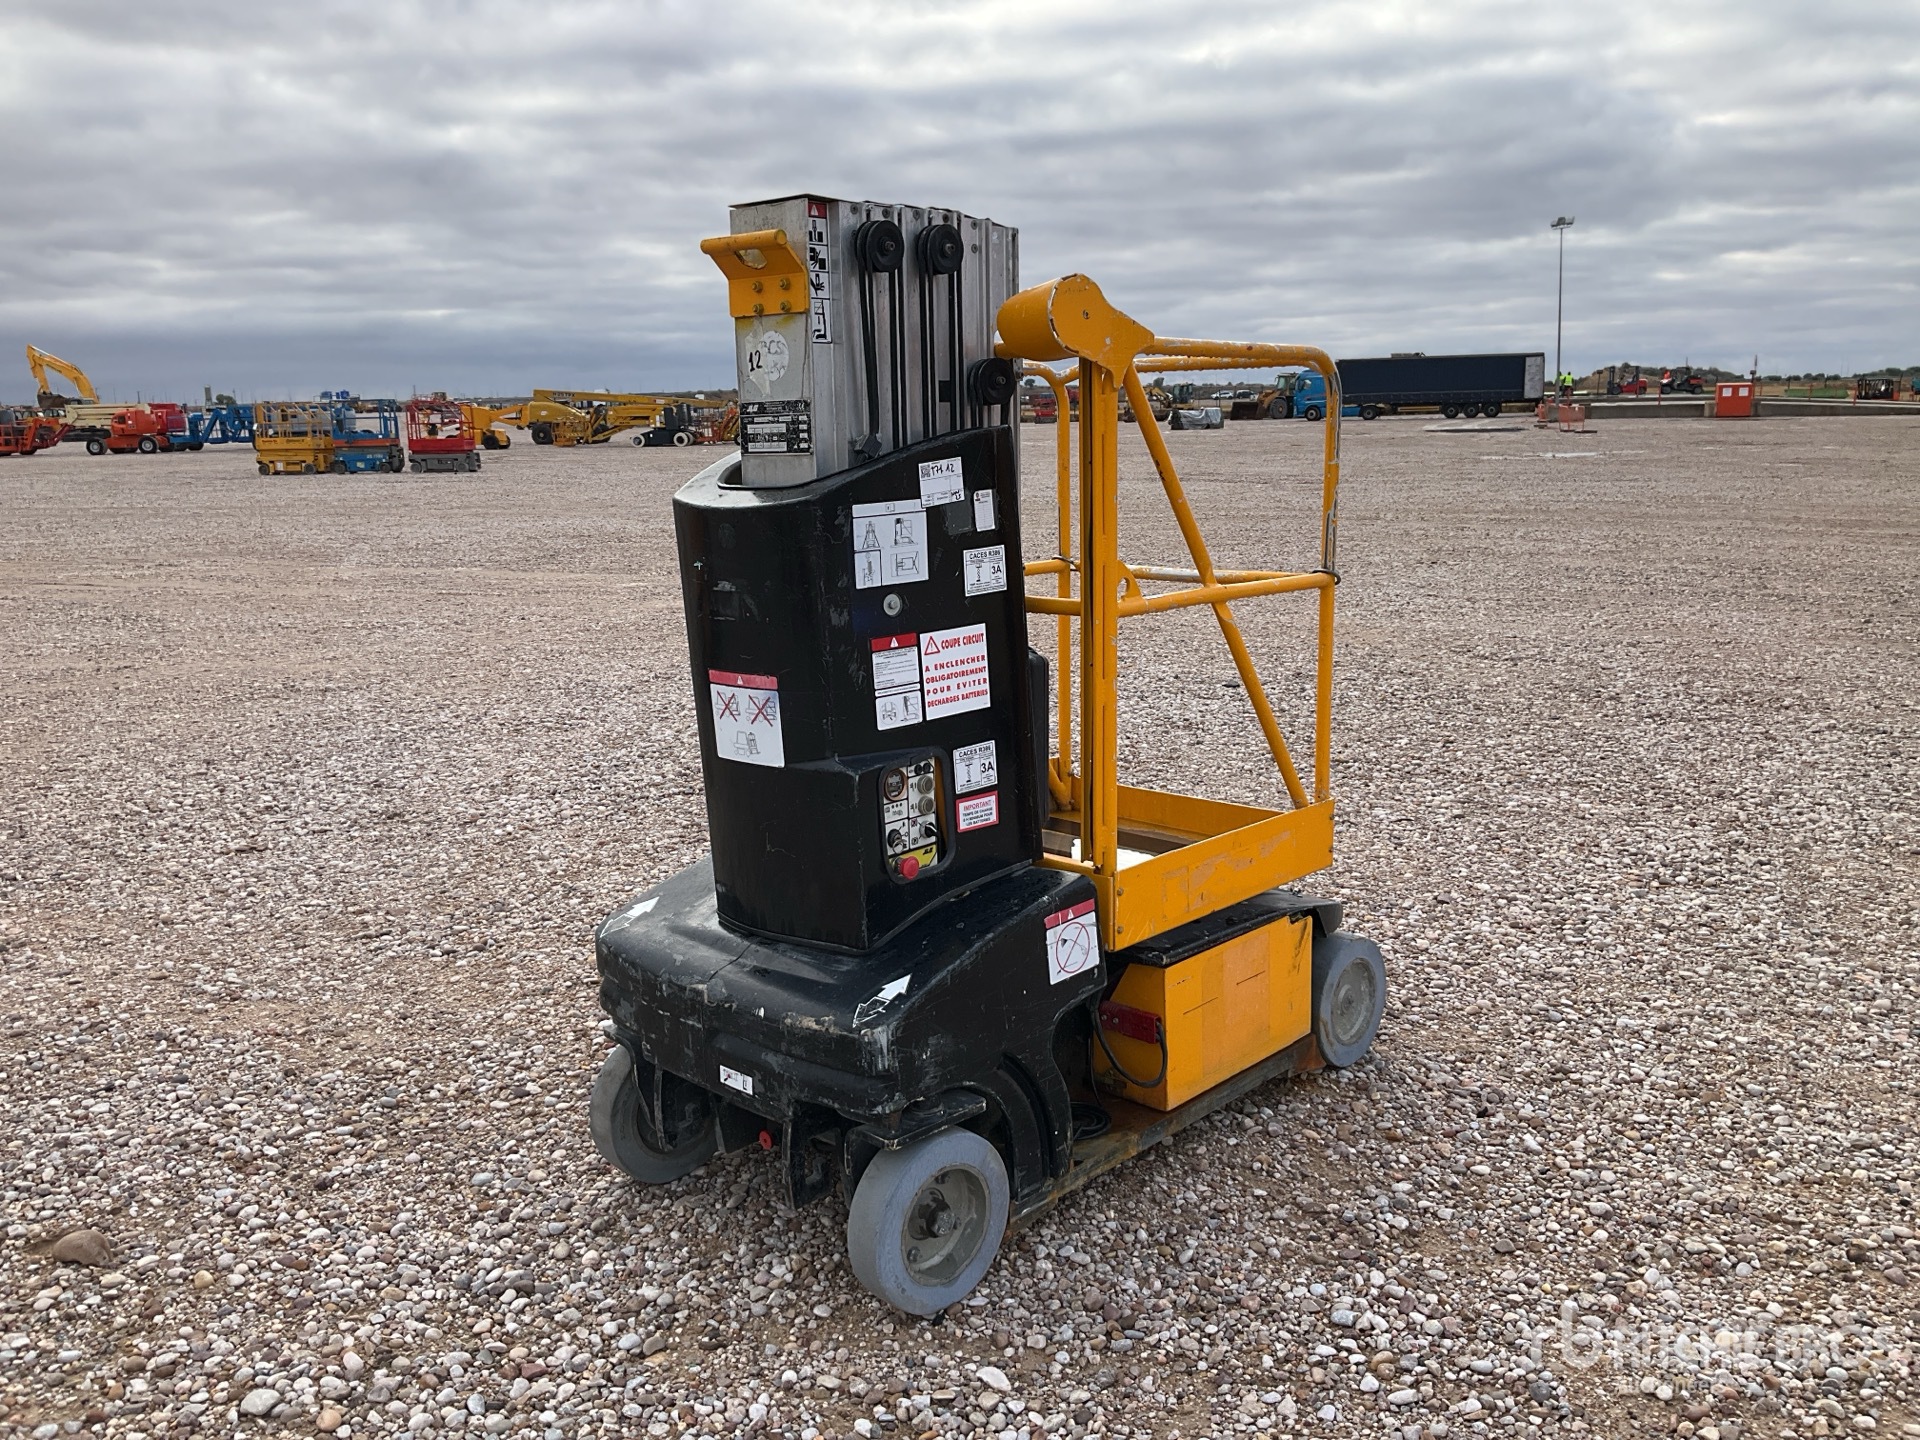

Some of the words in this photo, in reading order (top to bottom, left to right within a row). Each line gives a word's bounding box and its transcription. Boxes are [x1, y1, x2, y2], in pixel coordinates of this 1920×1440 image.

[749, 350, 763, 372] 12
[969, 551, 988, 560] CACES
[991, 564, 1002, 575] 3A
[941, 637, 961, 650] COUPE
[962, 632, 984, 646] CIRCUIT
[925, 665, 930, 673] A
[934, 655, 986, 671] ENCLENCHER
[925, 666, 987, 684] OBLIGATOIREMENT
[926, 685, 951, 696] POUR
[956, 677, 987, 690] EVITER
[927, 695, 960, 708] DECHARGES
[961, 688, 988, 701] BATTERIES
[959, 748, 977, 758] CACES
[981, 761, 994, 773] 3A
[964, 800, 991, 811] IMPORTANT
